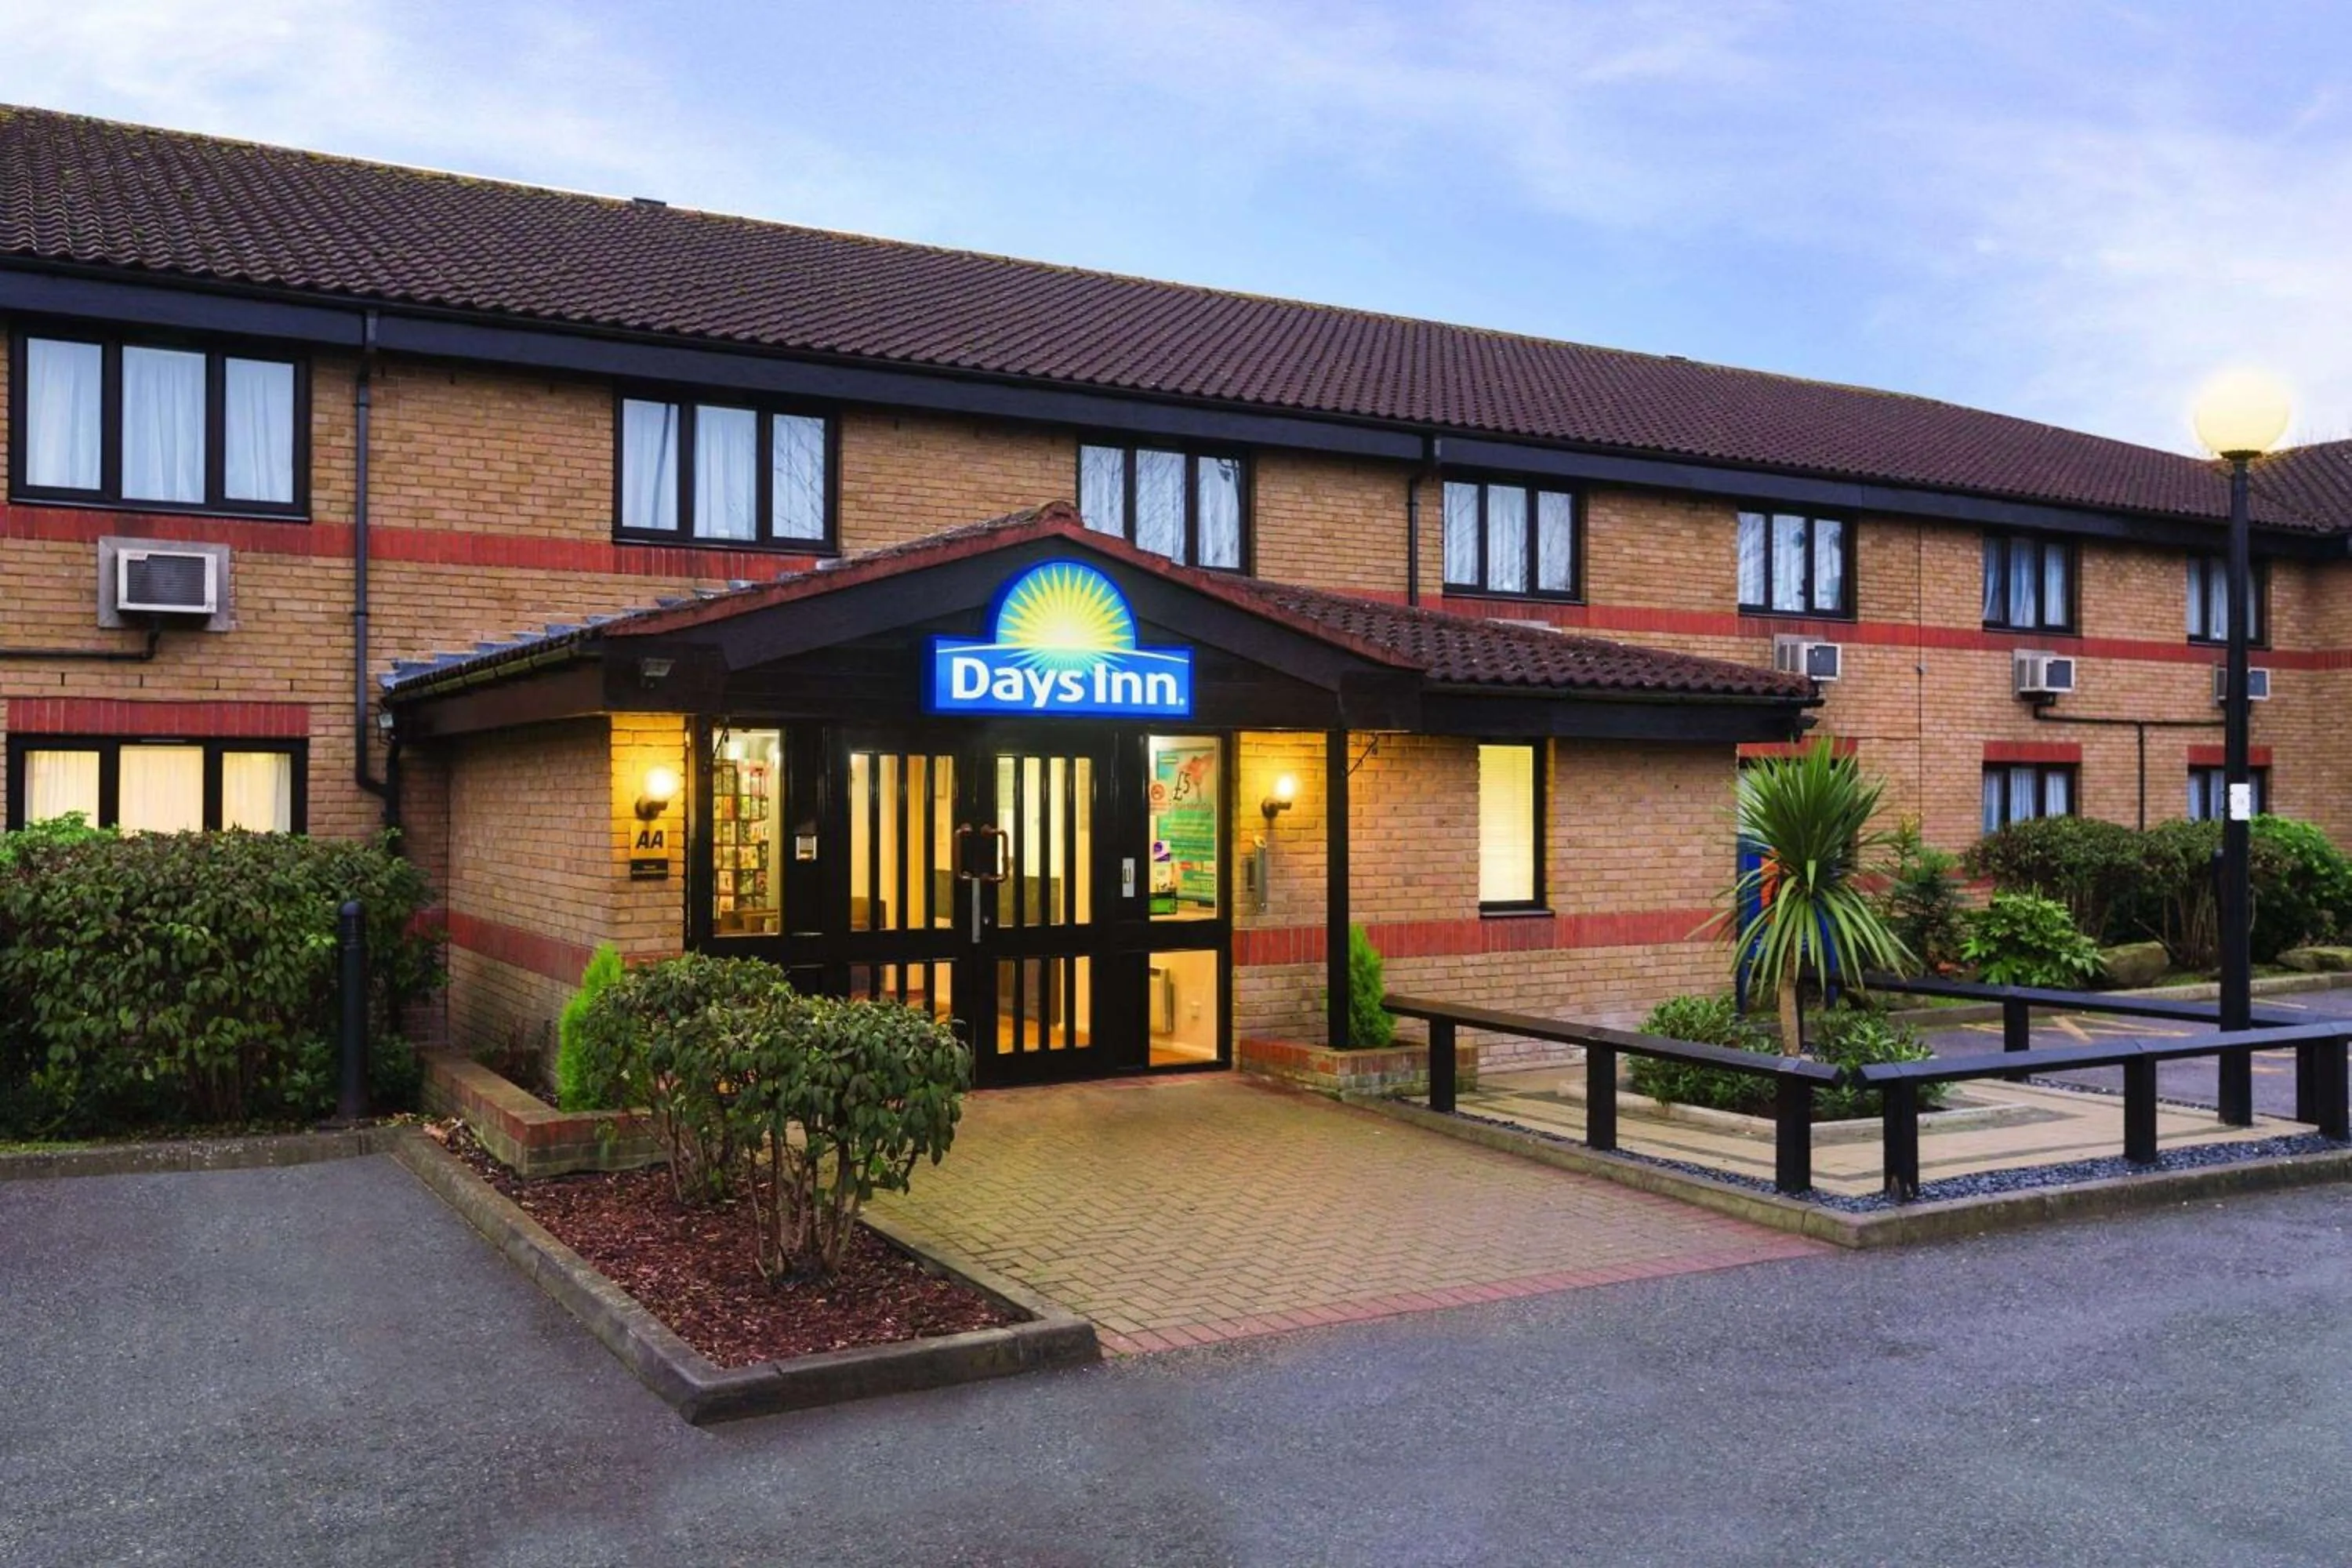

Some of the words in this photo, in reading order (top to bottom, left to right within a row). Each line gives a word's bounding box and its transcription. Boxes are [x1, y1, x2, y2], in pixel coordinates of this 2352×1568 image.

[952, 656, 1085, 708] Days
[1094, 662, 1178, 706] Inn
[636, 829, 663, 848] AA
